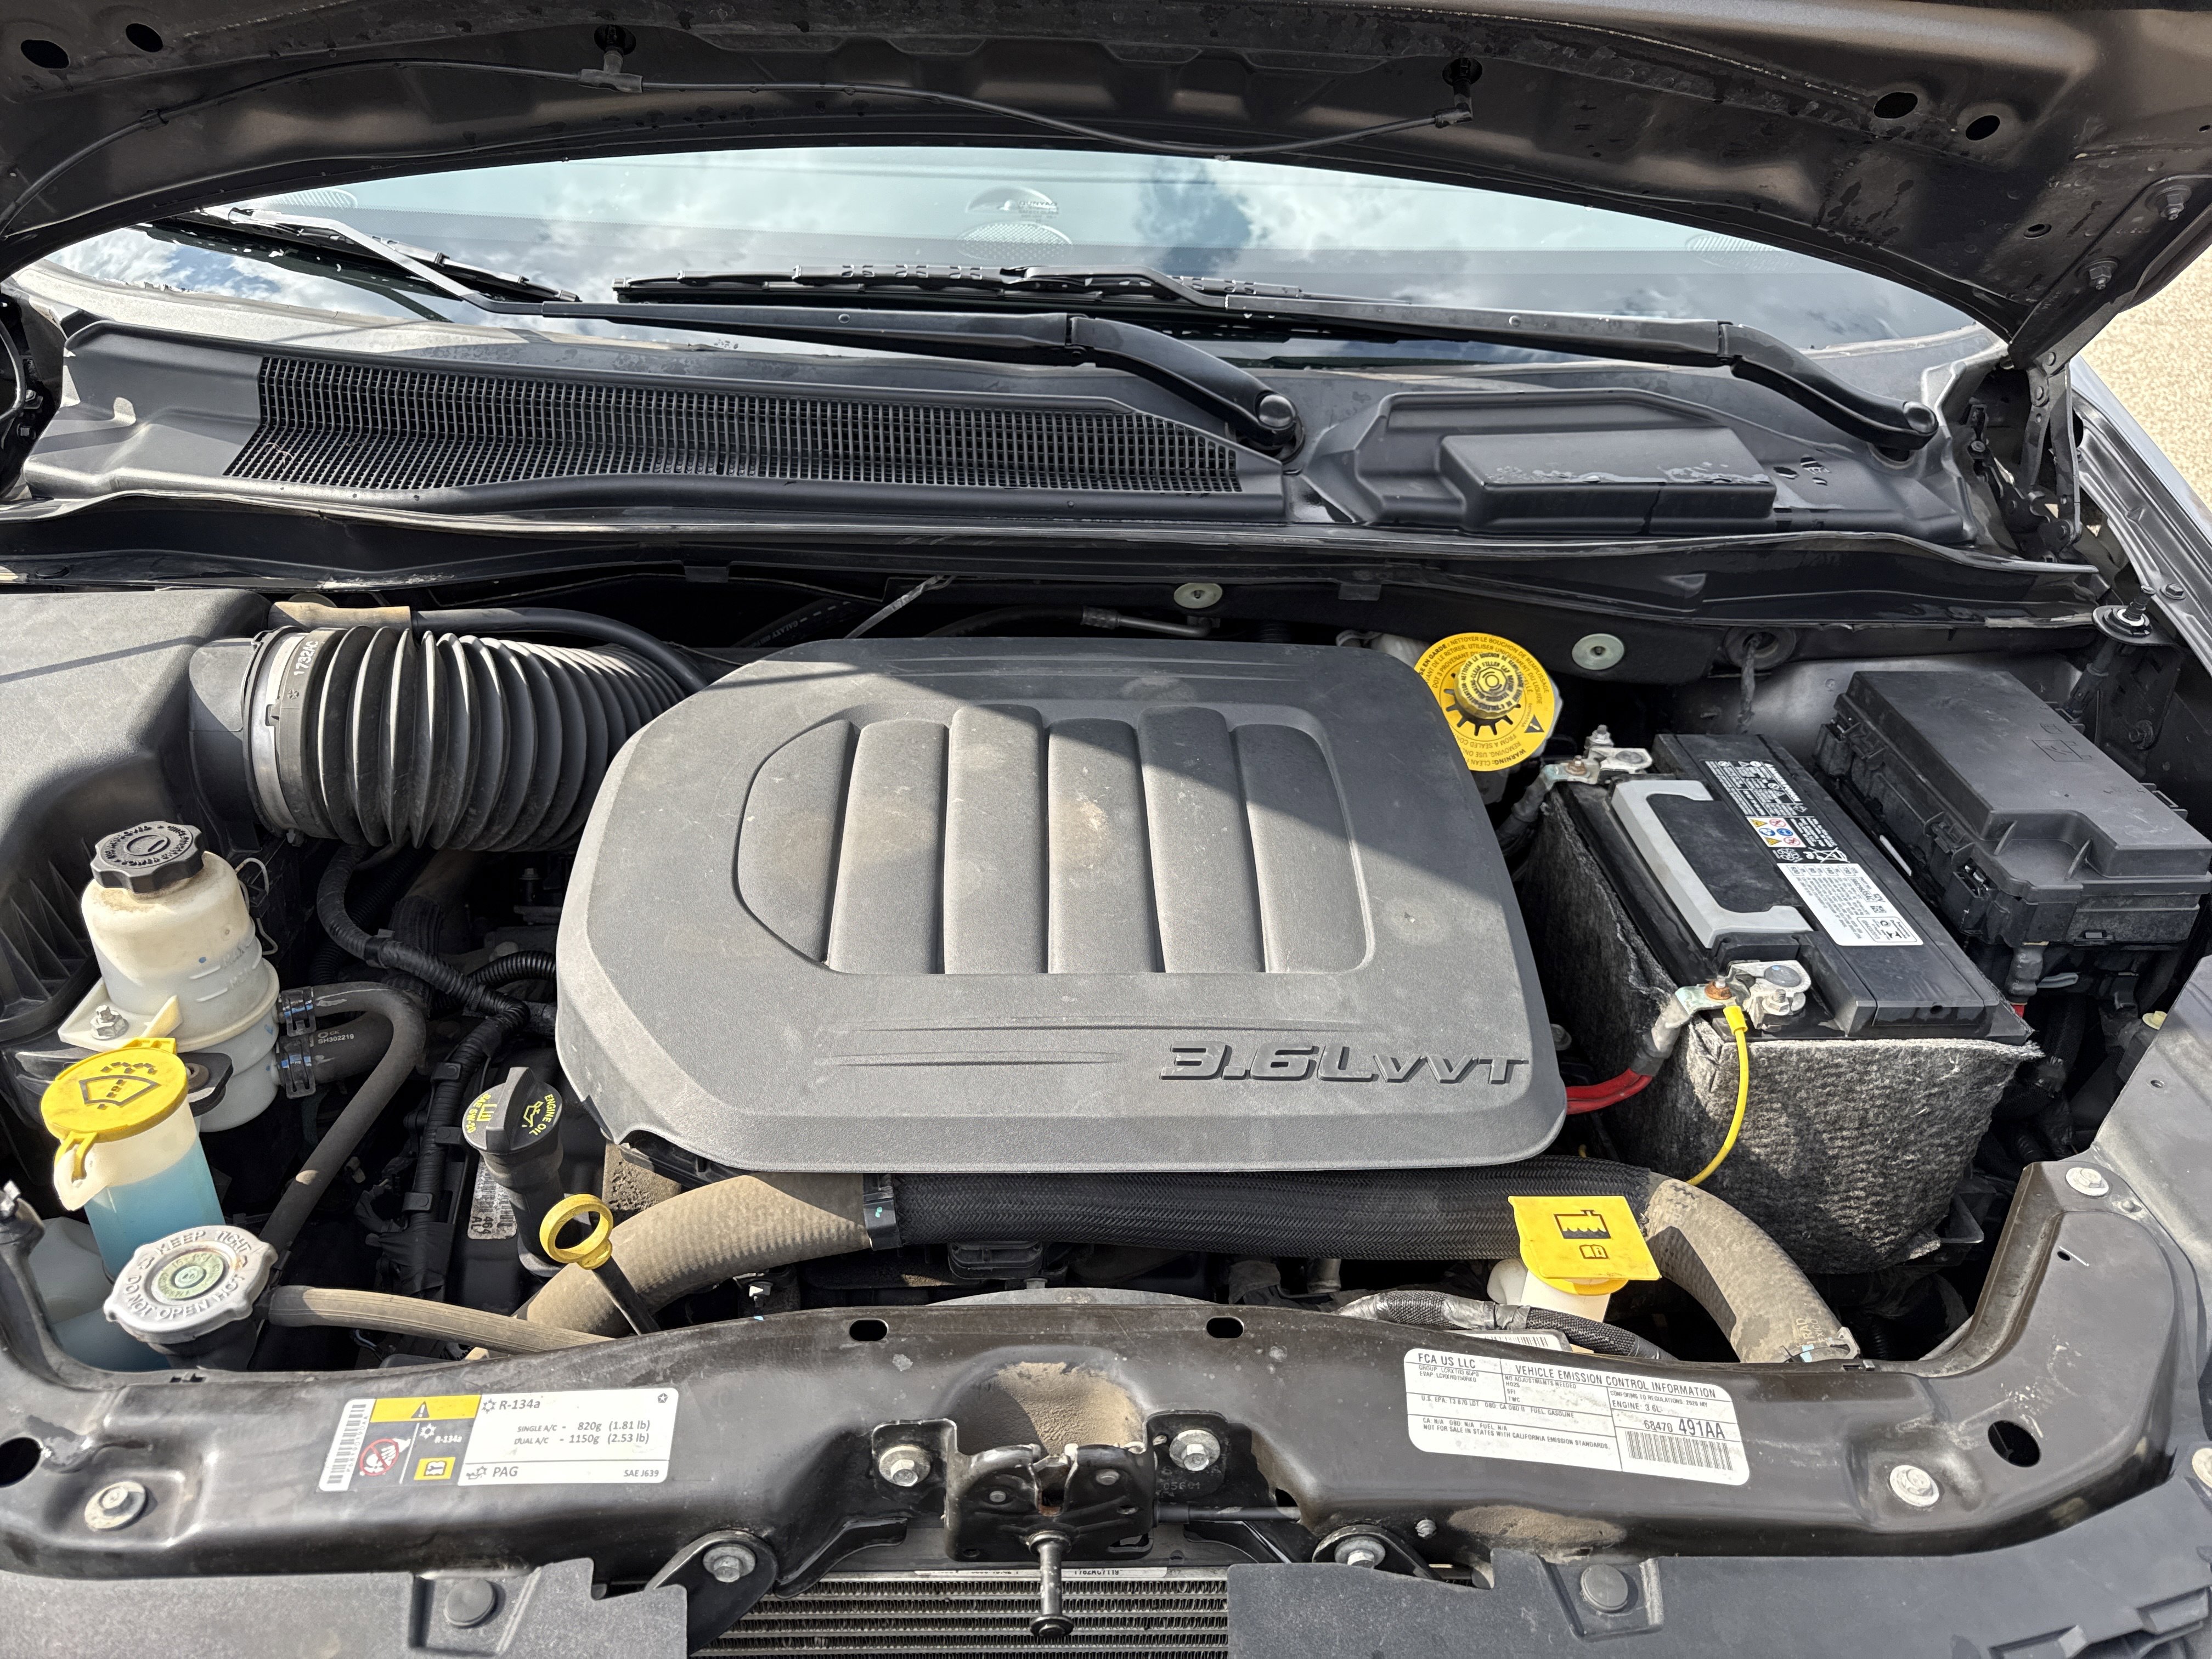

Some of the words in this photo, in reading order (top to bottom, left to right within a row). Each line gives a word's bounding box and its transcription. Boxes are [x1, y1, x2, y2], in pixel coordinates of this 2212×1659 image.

[294, 641, 319, 676] 1732AC
[1429, 644, 1447, 659] GARDE
[1450, 636, 1479, 645] NETTOYER
[1488, 637, 1518, 653] BOUCHON
[1518, 650, 1527, 658] DE
[1525, 656, 1549, 693] REMPLISSAGE
[1431, 659, 1440, 668] DE
[1439, 652, 1469, 673] PROVENANT
[1500, 733, 1517, 746] FROM
[1492, 748, 1526, 765] WARNING:
[1160, 1041, 1375, 1081] 3.6L
[1374, 1053, 1529, 1084] VVT
[472, 1093, 492, 1108] SAE
[542, 1093, 557, 1124] ENGINE
[466, 1108, 478, 1133] 5W-20
[528, 1122, 546, 1136] OIL
[154, 1230, 206, 1255] KEEP
[216, 1229, 251, 1254] TIGHT
[123, 1275, 142, 1294] DO
[213, 1273, 245, 1304] HOT
[127, 1296, 157, 1316] NOT
[155, 1299, 211, 1320] OPEN
[1418, 1353, 1437, 1364] FCA
[1441, 1355, 1454, 1367] US
[1458, 1357, 1476, 1369] LLC
[1514, 1376, 1554, 1386] ADJUSTMENTS
[1555, 1381, 1577, 1389] NEEDED
[1515, 1364, 1555, 1379] VEHICLE
[1558, 1370, 1602, 1385] EMISSION
[1605, 1375, 1649, 1391] CONTROL
[1651, 1381, 1716, 1398] INFORMATION
[1610, 1390, 1639, 1400] CONFORMS
[499, 1399, 541, 1410] R-134a
[1612, 1400, 1642, 1410] ENGINE:
[1547, 1409, 1575, 1418] GASOLINE
[543, 1424, 558, 1432] A/C
[577, 1421, 602, 1432] 820g
[608, 1420, 634, 1432] (1.81
[636, 1420, 651, 1431] lb)
[1644, 1419, 1674, 1433] 68470
[1678, 1418, 1726, 1439] 491AA
[434, 1435, 462, 1443] R-134a
[568, 1434, 600, 1445] 1150g
[607, 1434, 634, 1445] (2.53
[635, 1432, 650, 1444] lb)
[1473, 1428, 1494, 1436] STATES
[1512, 1432, 1545, 1442] CALIFORNIA
[1547, 1436, 1574, 1445] EMISSION
[1575, 1440, 1611, 1450] STANDARDS.
[493, 1466, 519, 1477] PAG
[640, 1469, 659, 1477] J639
